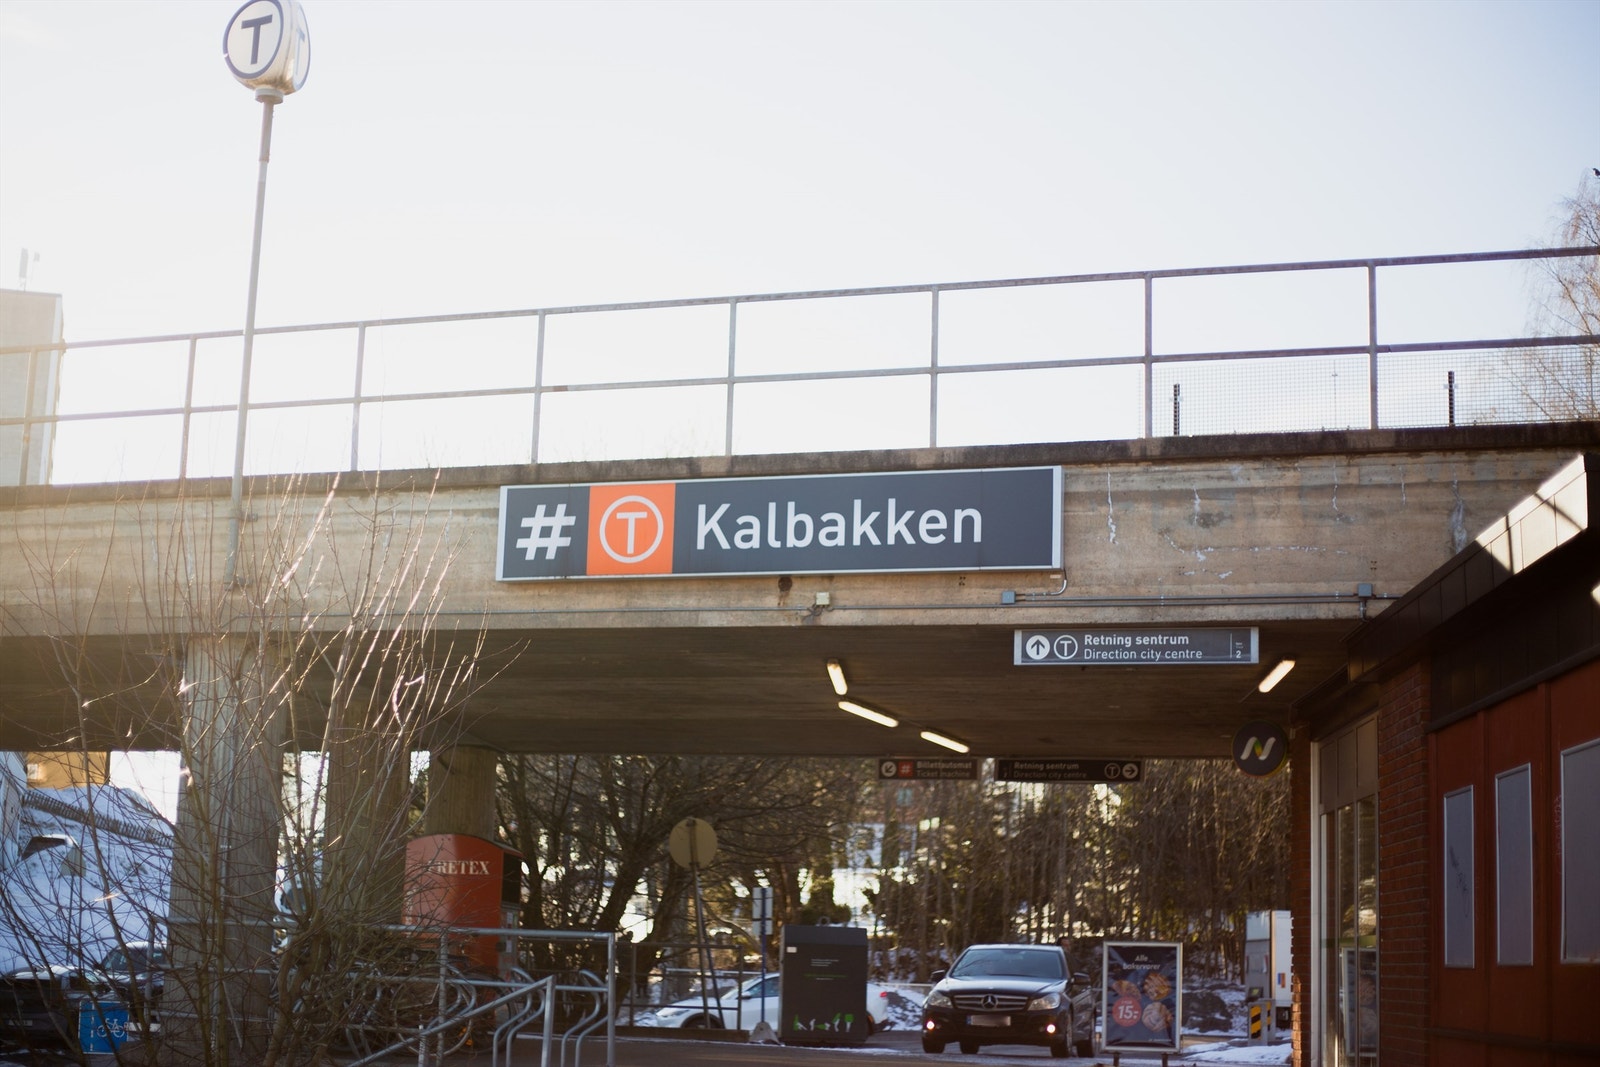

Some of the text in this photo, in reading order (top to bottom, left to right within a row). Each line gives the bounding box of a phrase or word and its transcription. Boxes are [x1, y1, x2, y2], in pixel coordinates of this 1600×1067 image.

[241, 14, 273, 65] T
[616, 511, 648, 555] T
[696, 498, 983, 551] Kalbakken
[1084, 634, 1132, 648] Retning
[1135, 634, 1190, 645] sentrum
[1084, 648, 1203, 662] Direction city centre
[1235, 649, 1242, 659] 2
[916, 761, 973, 769] Billettautomat
[1014, 762, 1079, 772] Retning sentrum
[916, 770, 939, 778] Ticket
[1013, 770, 1047, 778] Direction
[1135, 954, 1149, 962] Alle
